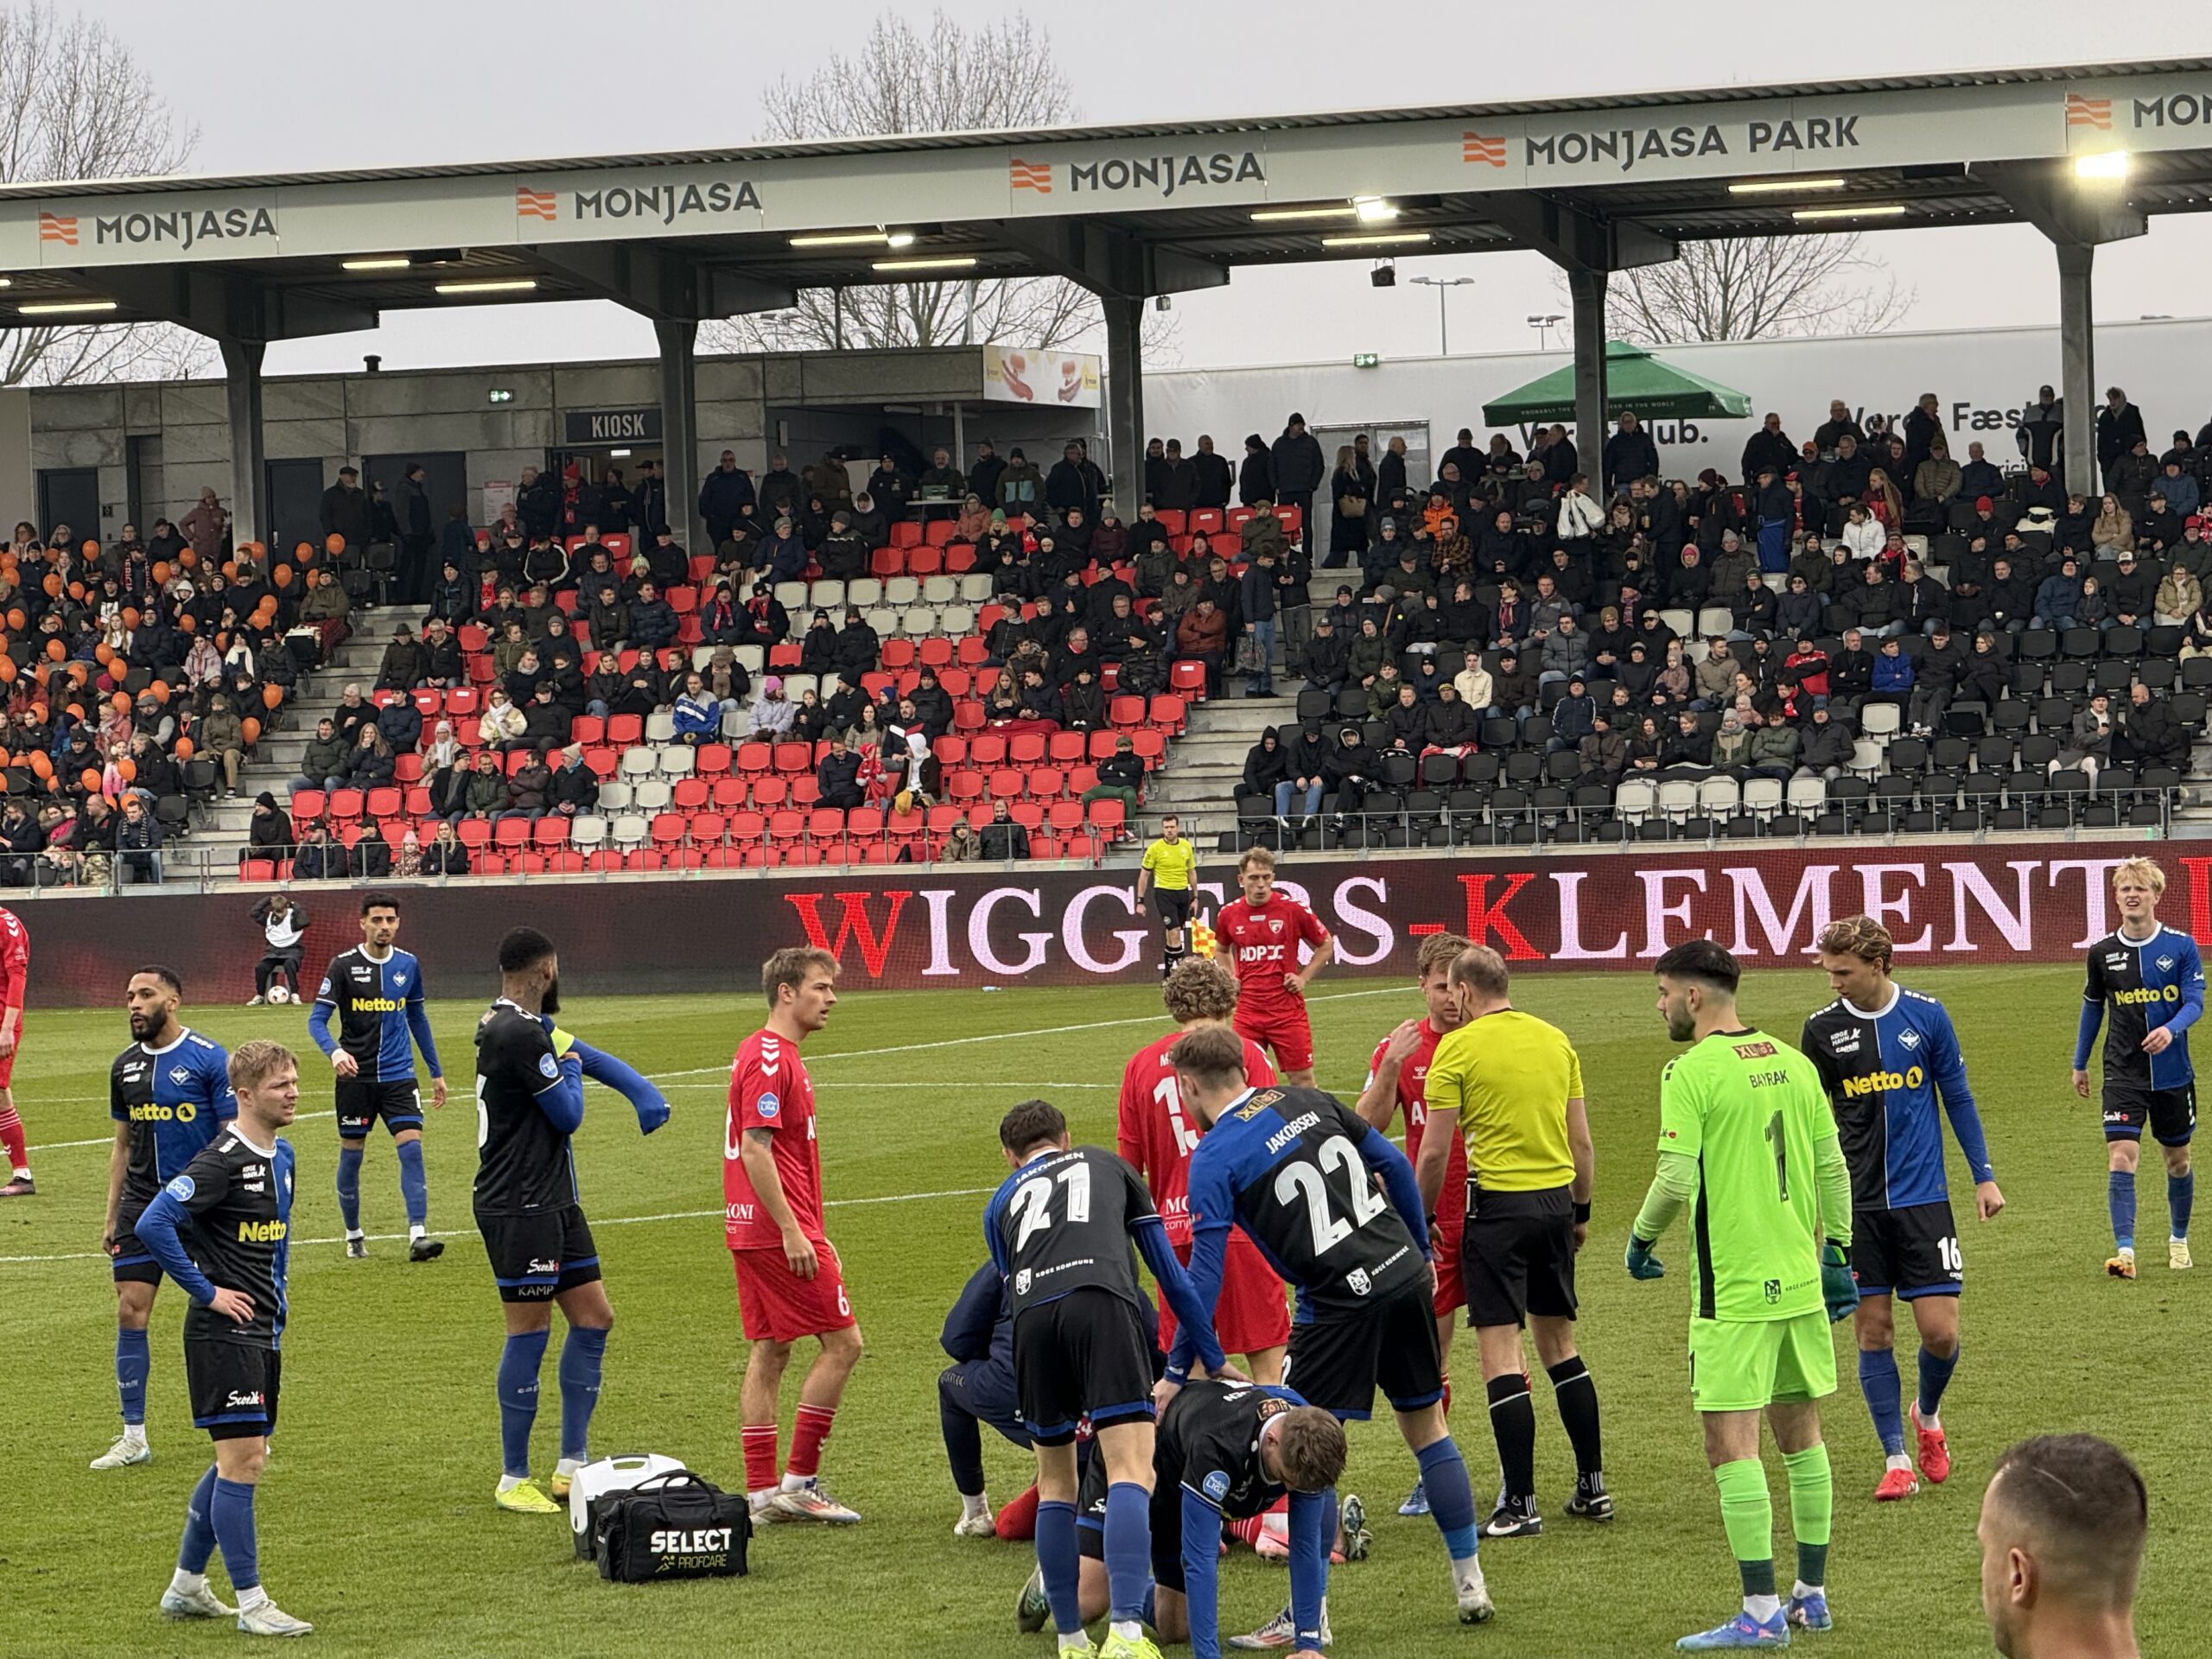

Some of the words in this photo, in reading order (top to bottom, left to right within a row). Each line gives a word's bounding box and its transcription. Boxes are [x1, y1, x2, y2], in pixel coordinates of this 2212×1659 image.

[2134, 93, 2212, 128] MO
[1525, 124, 1728, 171] MONJASA
[1748, 116, 1859, 153] PARK
[1071, 152, 1265, 198] MONJASA
[574, 181, 762, 226] MONJASA
[97, 207, 277, 250] MONJASA
[591, 414, 645, 438] KIOSK
[352, 997, 397, 1012] Netto
[2114, 988, 2161, 1007] Netto
[1749, 1070, 1790, 1089] BAYRAK
[1843, 1071, 1904, 1099] Netto
[1265, 1110, 1321, 1155] JAKOBSEN
[1764, 1109, 1789, 1203] 1
[1009, 1161, 1090, 1253] 21
[1274, 1135, 1388, 1257] 22
[238, 1219, 287, 1243] Netto
[1056, 1258, 1095, 1271] KOMMUNE
[1937, 1236, 1962, 1270] 16
[518, 1284, 556, 1297] KAMP
[837, 1284, 850, 1317] 6
[650, 1528, 733, 1554] SELECT
[677, 1554, 728, 1569] PROFCARE
